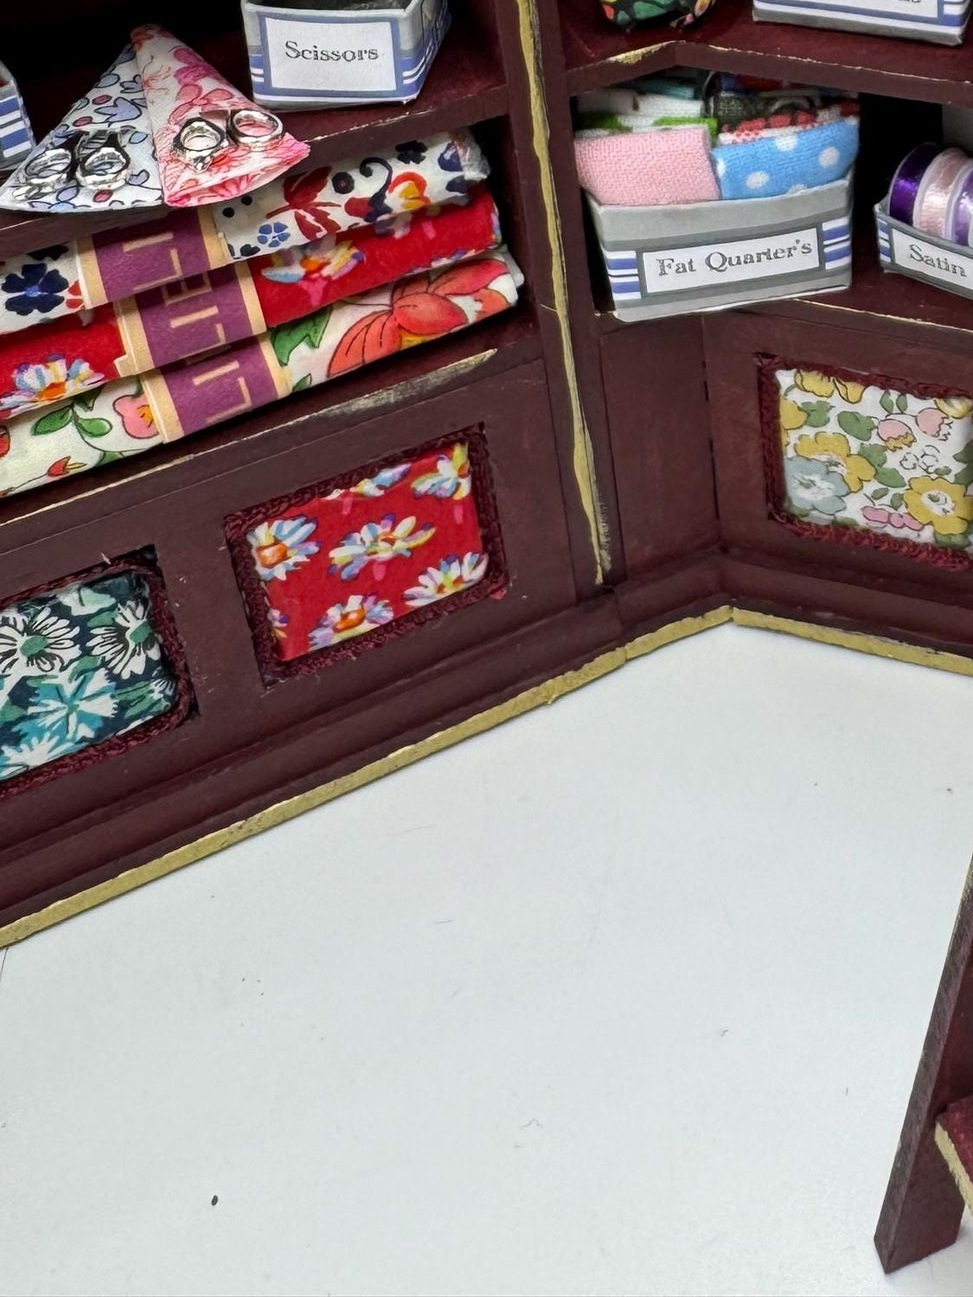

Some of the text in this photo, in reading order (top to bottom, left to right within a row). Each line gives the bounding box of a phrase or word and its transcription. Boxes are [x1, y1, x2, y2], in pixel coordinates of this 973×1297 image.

[285, 40, 379, 63] Scissors
[656, 239, 813, 277] Fat Quarter's
[908, 243, 967, 278] Satin
